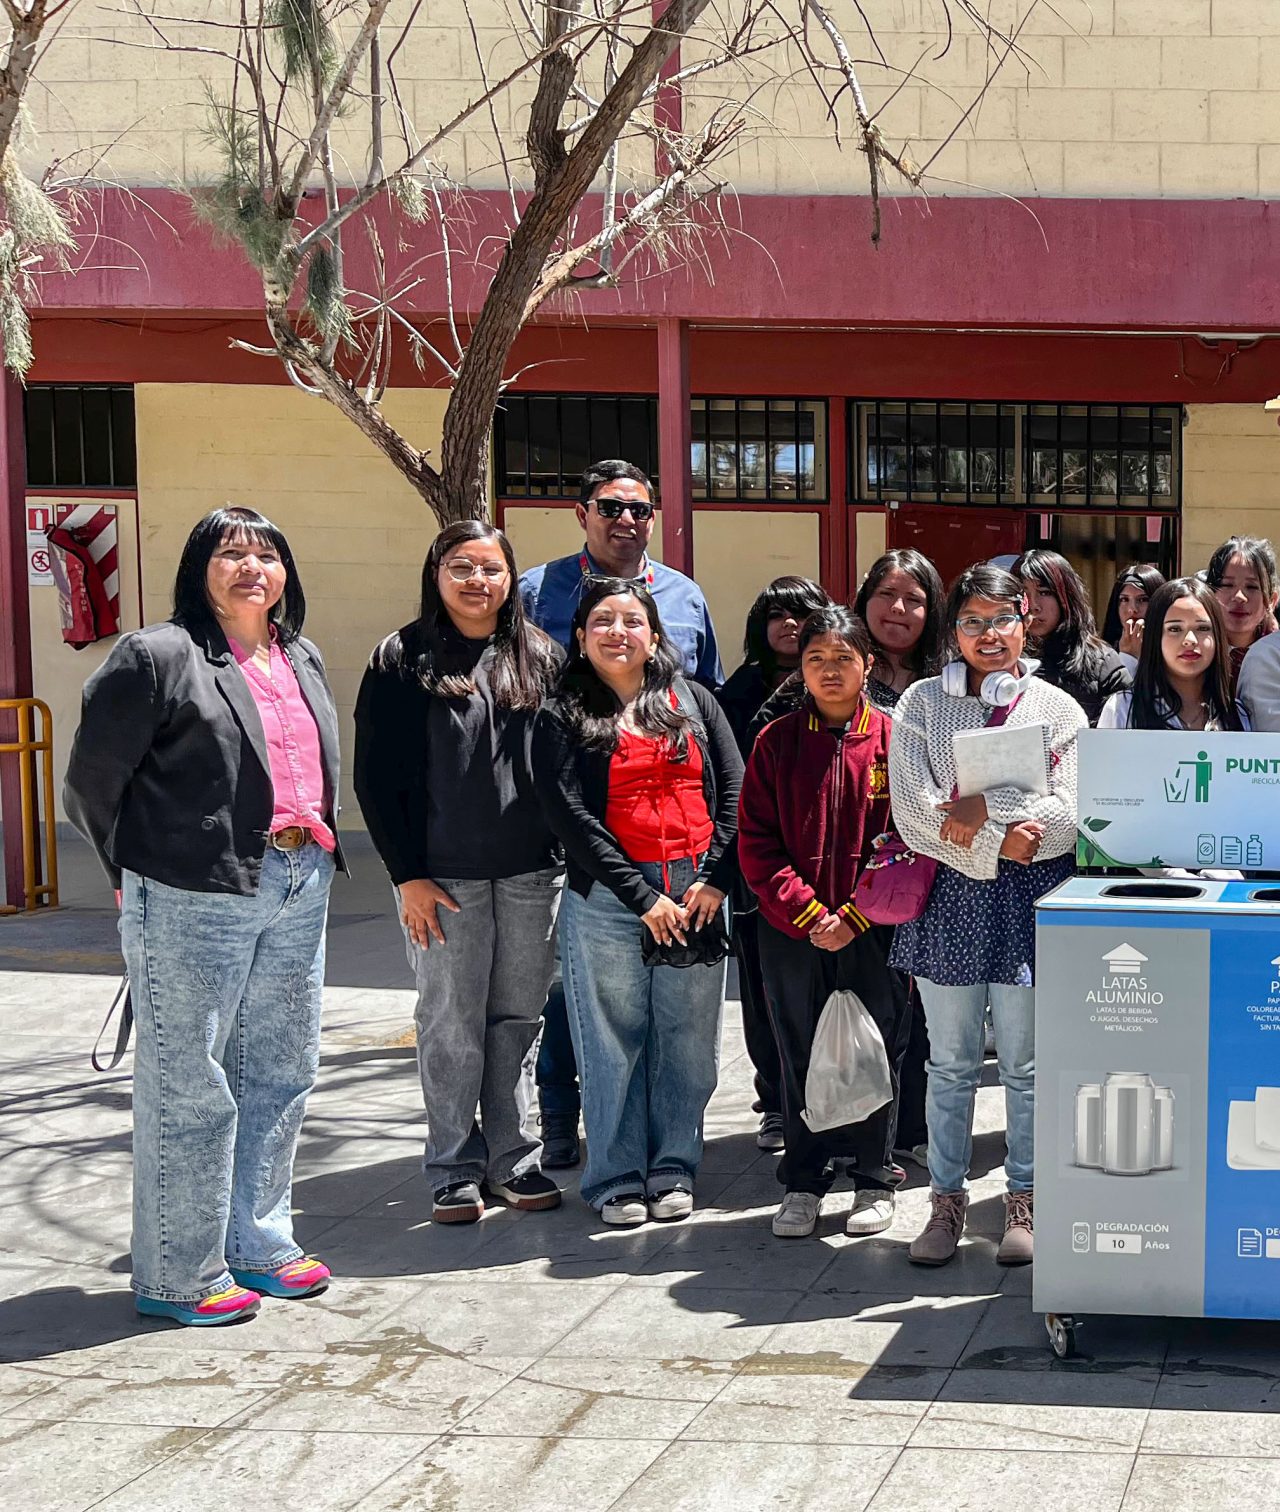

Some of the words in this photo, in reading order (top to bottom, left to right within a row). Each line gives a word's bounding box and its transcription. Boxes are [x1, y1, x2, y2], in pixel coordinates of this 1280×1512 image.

[1102, 976, 1148, 990] LATAS
[1085, 990, 1164, 1005] ALUMINIO
[1122, 1016, 1159, 1024] DESECHOS
[1096, 1222, 1169, 1233] DEGRADACIÓN
[1112, 1240, 1125, 1249] 10
[1144, 1241, 1170, 1250] Años
